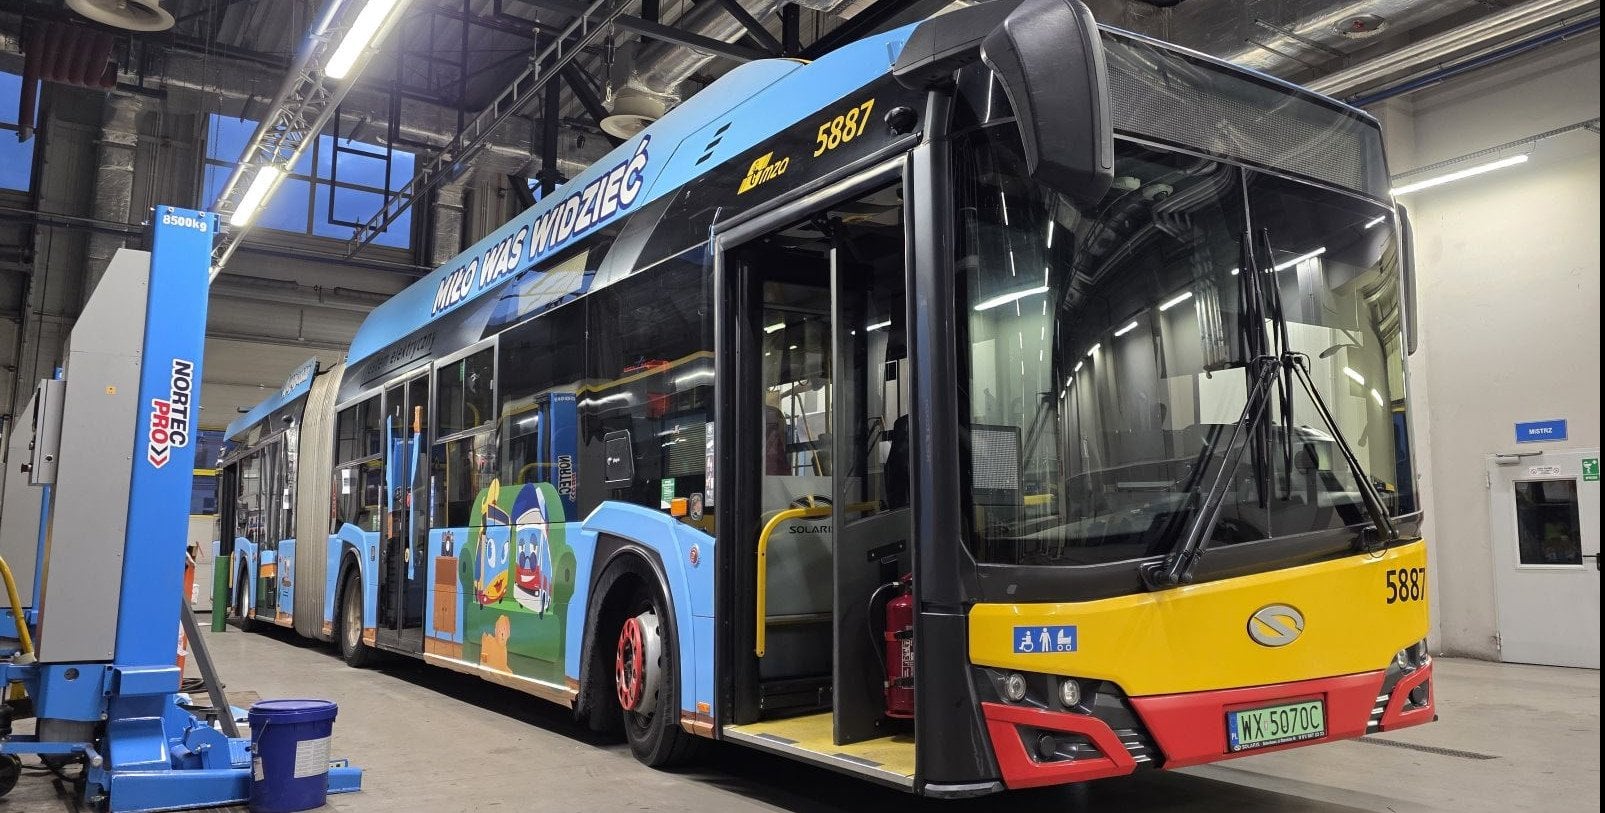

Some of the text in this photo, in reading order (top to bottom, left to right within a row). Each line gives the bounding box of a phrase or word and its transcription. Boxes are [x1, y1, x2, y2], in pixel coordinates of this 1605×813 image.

[813, 98, 875, 158] 5887
[162, 213, 208, 233] 8500kg
[431, 134, 651, 317] MIŁO WAS WIDZIEĆ
[150, 400, 171, 445] PRO
[169, 360, 192, 447] NORTEC
[1528, 427, 1553, 435] MISTRZ
[1386, 567, 1426, 604] 5887
[1231, 705, 1320, 741] PL WX 5070C
